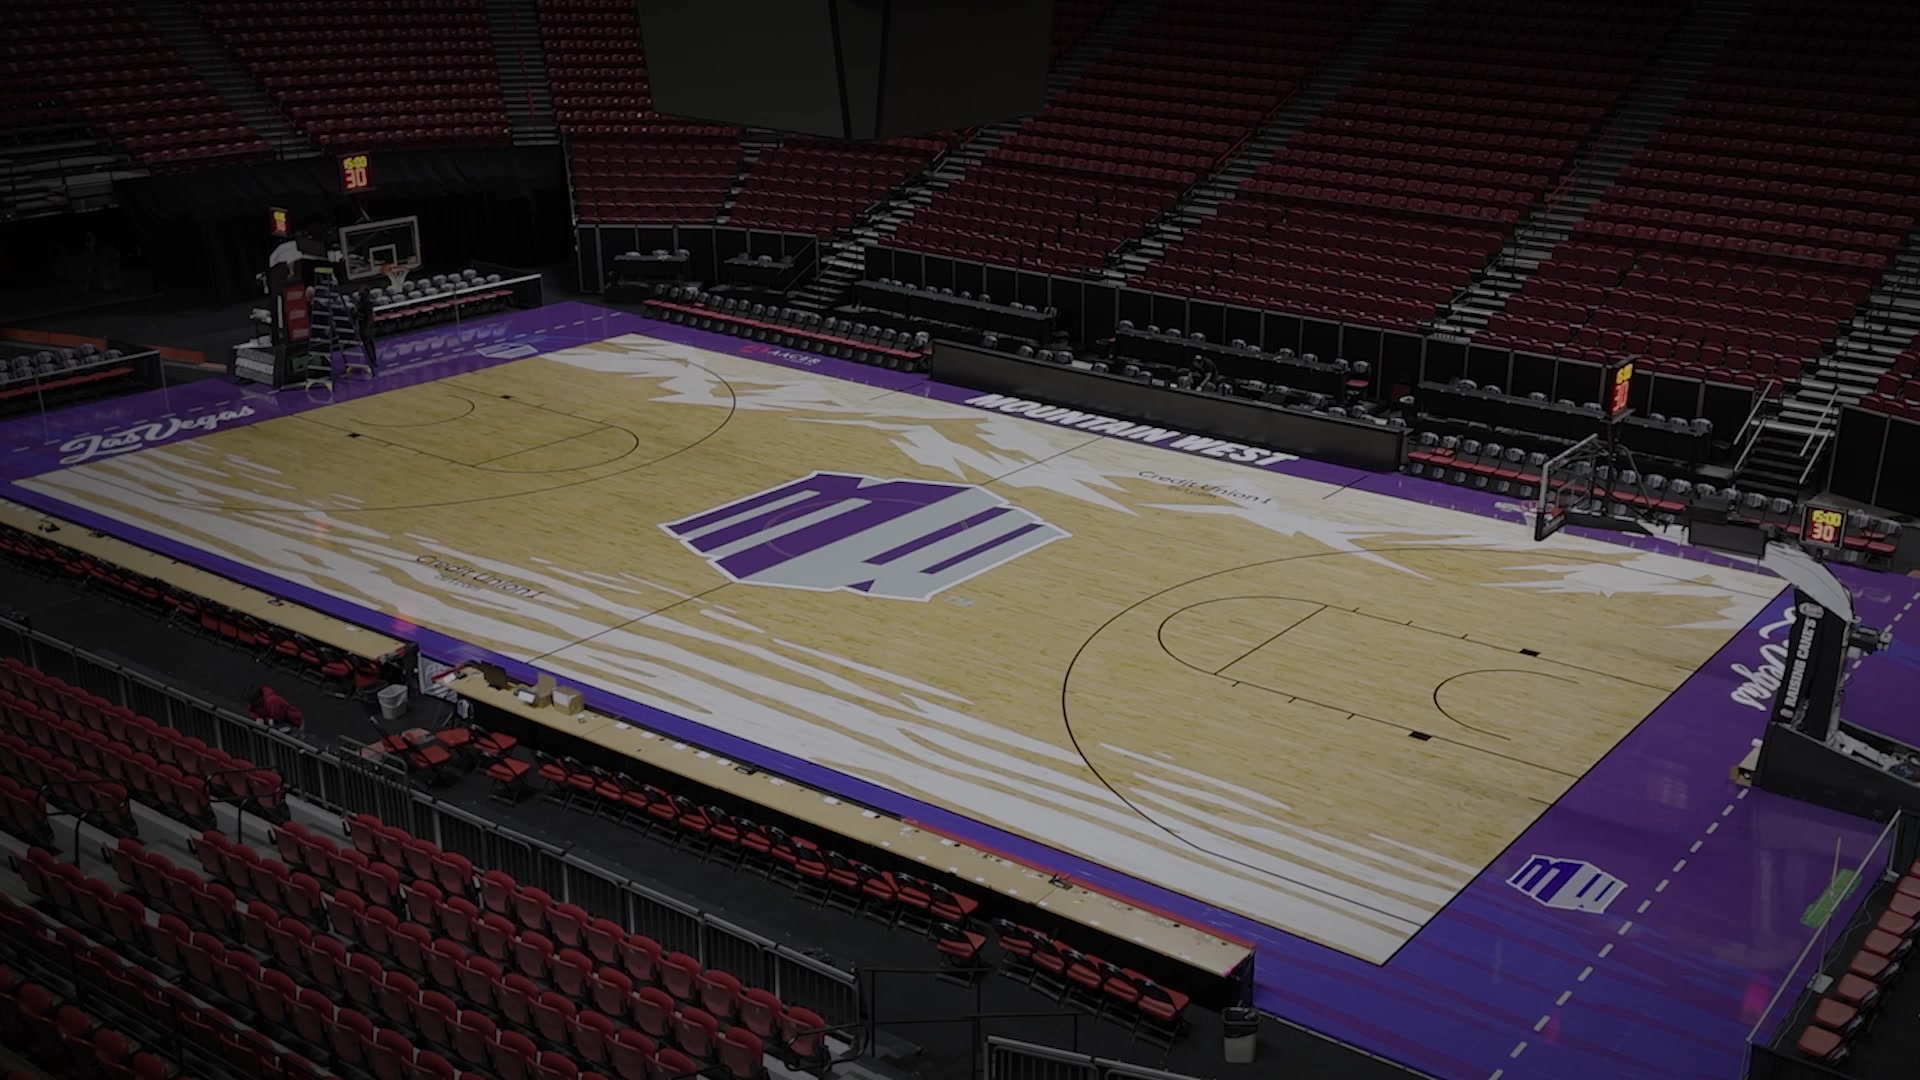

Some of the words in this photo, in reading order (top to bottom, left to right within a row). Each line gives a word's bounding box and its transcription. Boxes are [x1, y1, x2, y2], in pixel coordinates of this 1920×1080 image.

[344, 168, 368, 189] 30
[111, 405, 255, 441] Vegas
[965, 393, 1181, 443] MOUNTAIN
[1169, 434, 1300, 466] WEST
[1811, 522, 1835, 541] 30
[1783, 658, 1808, 708] RAISING
